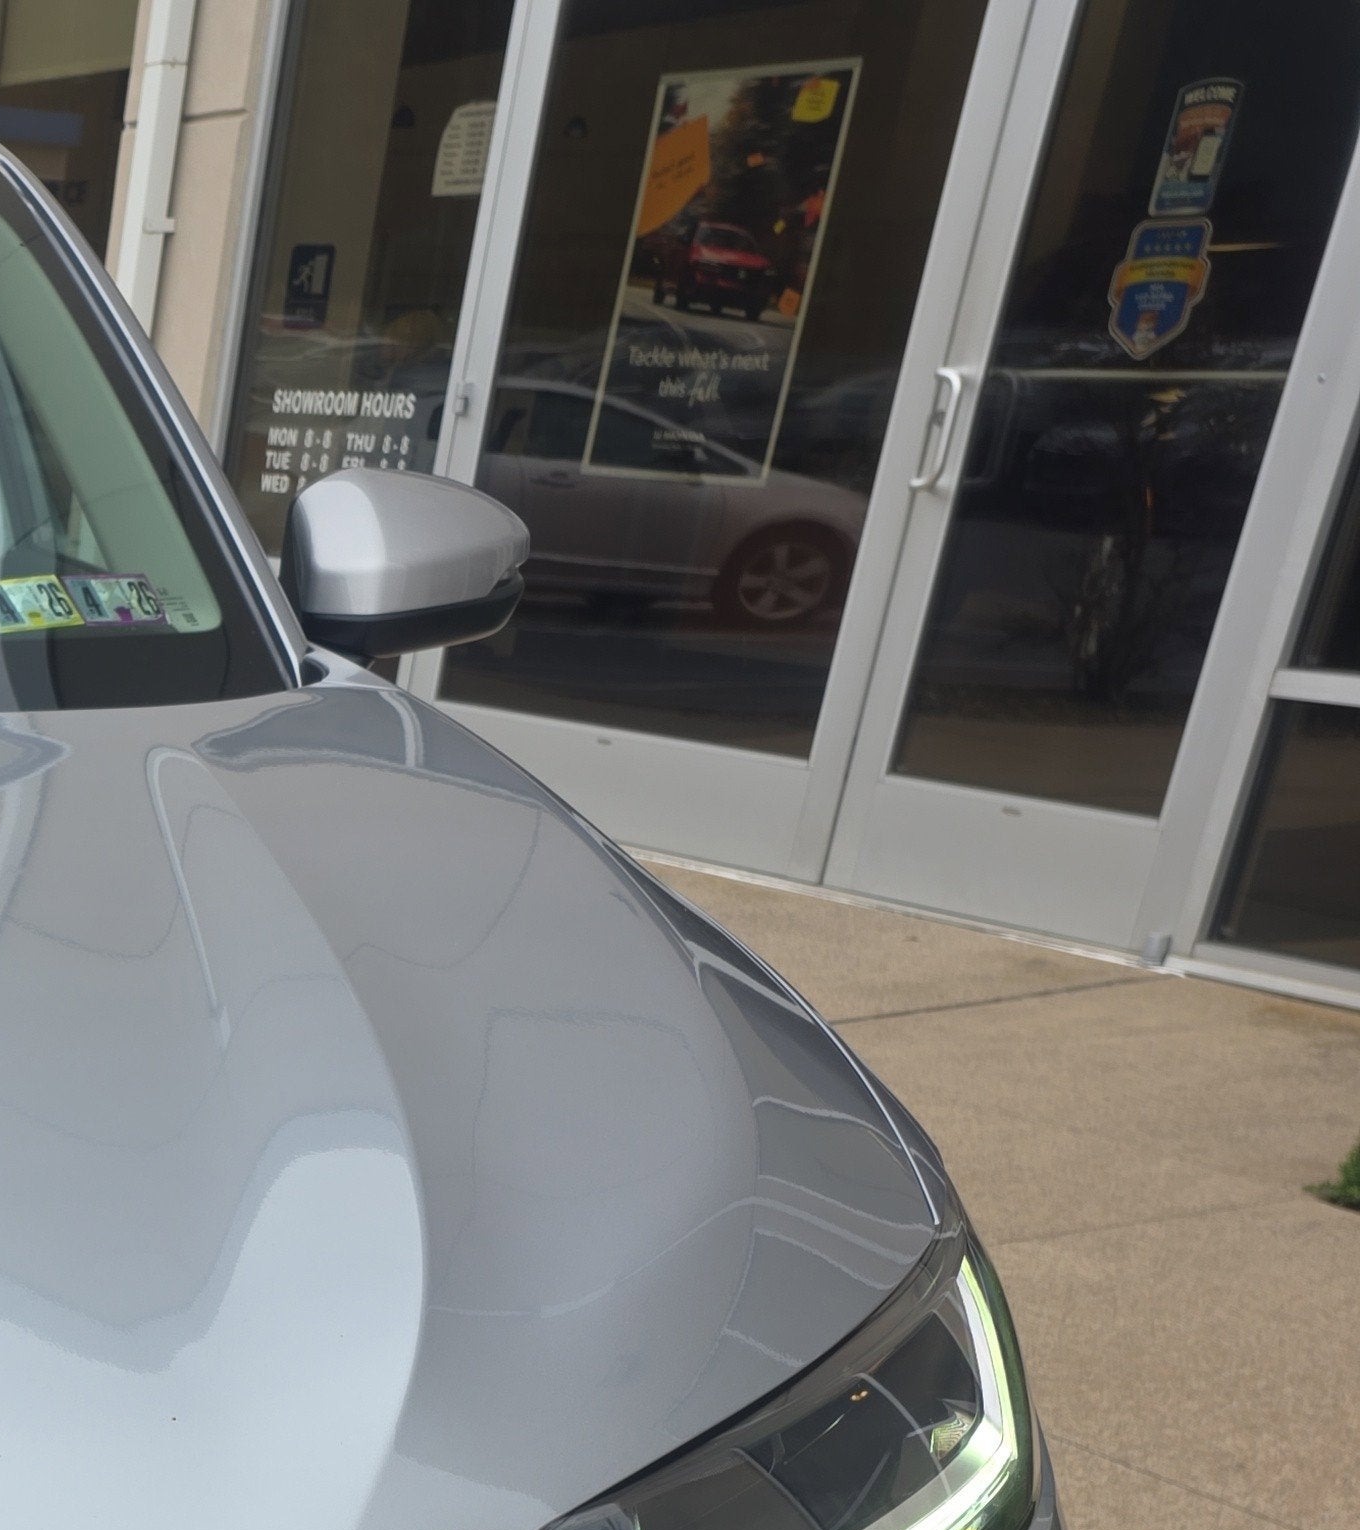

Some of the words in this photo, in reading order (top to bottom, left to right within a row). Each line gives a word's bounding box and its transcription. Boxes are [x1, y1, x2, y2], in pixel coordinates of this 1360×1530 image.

[1184, 85, 1237, 105] WELCOME
[732, 352, 770, 371] next
[658, 375, 686, 398] this
[272, 389, 359, 416] SHOWROOM
[361, 392, 417, 419] HOURS
[267, 427, 299, 447] MON
[346, 432, 376, 452] THU
[265, 451, 292, 470] TUE
[261, 473, 291, 493] WED
[37, 582, 74, 617] 26
[82, 586, 104, 617] 4
[128, 580, 161, 617] 26
